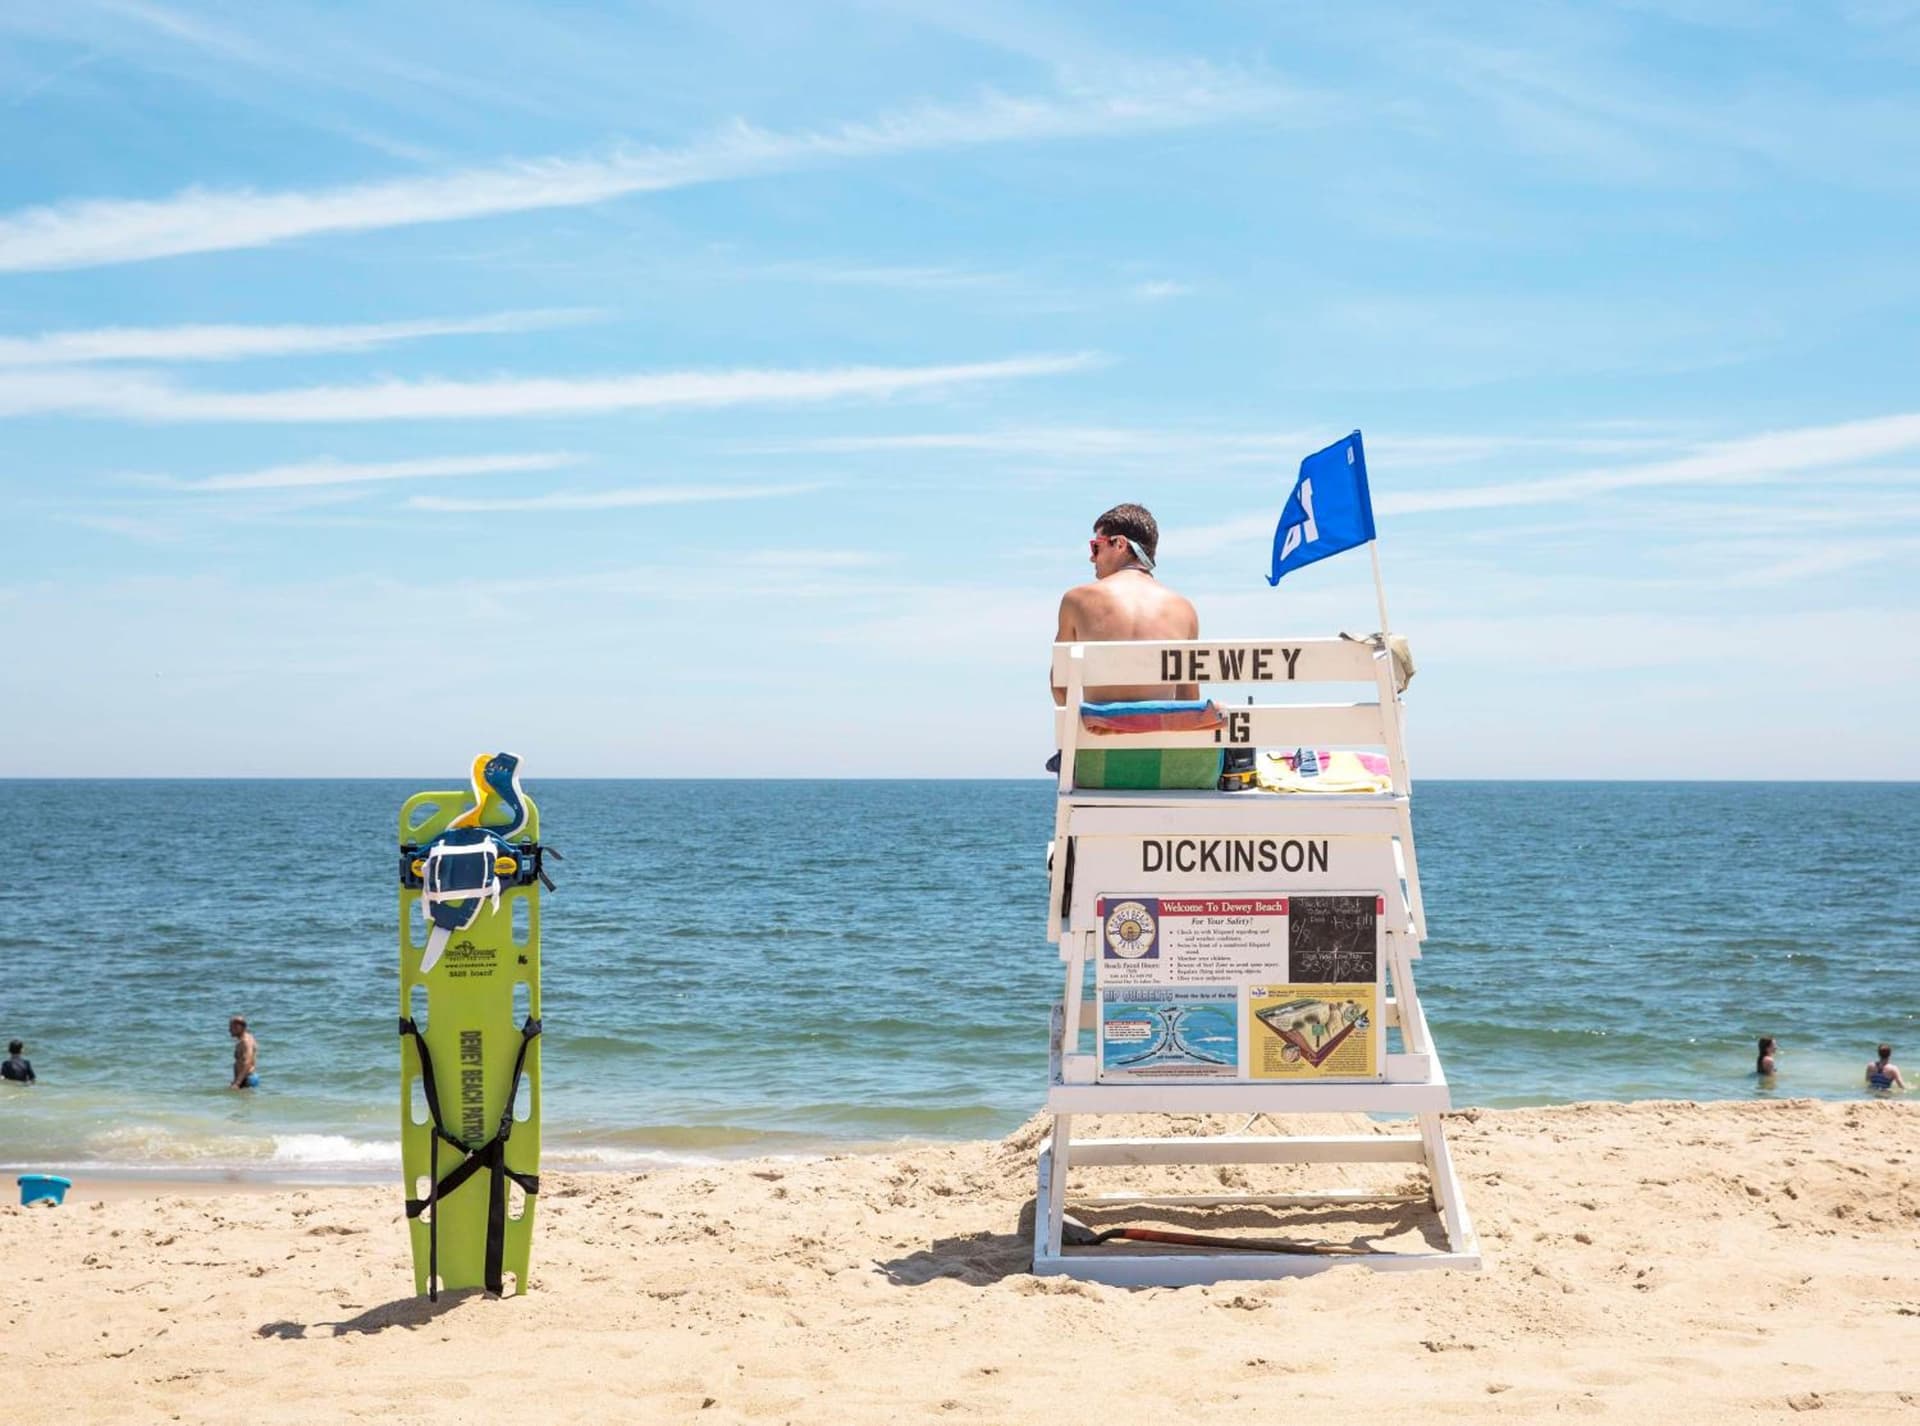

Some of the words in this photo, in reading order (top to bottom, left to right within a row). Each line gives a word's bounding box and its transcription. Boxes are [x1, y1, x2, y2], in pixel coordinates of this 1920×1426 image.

[1161, 649, 1301, 681] DEWEY
[1143, 840, 1328, 872] DICKINSON
[1163, 902, 1203, 912] Welcome
[1206, 902, 1219, 912] To
[1221, 902, 1253, 915] Dewey
[1256, 901, 1282, 912] Beach
[460, 1031, 482, 1066] DEWEY
[461, 1070, 484, 1104] BEACH
